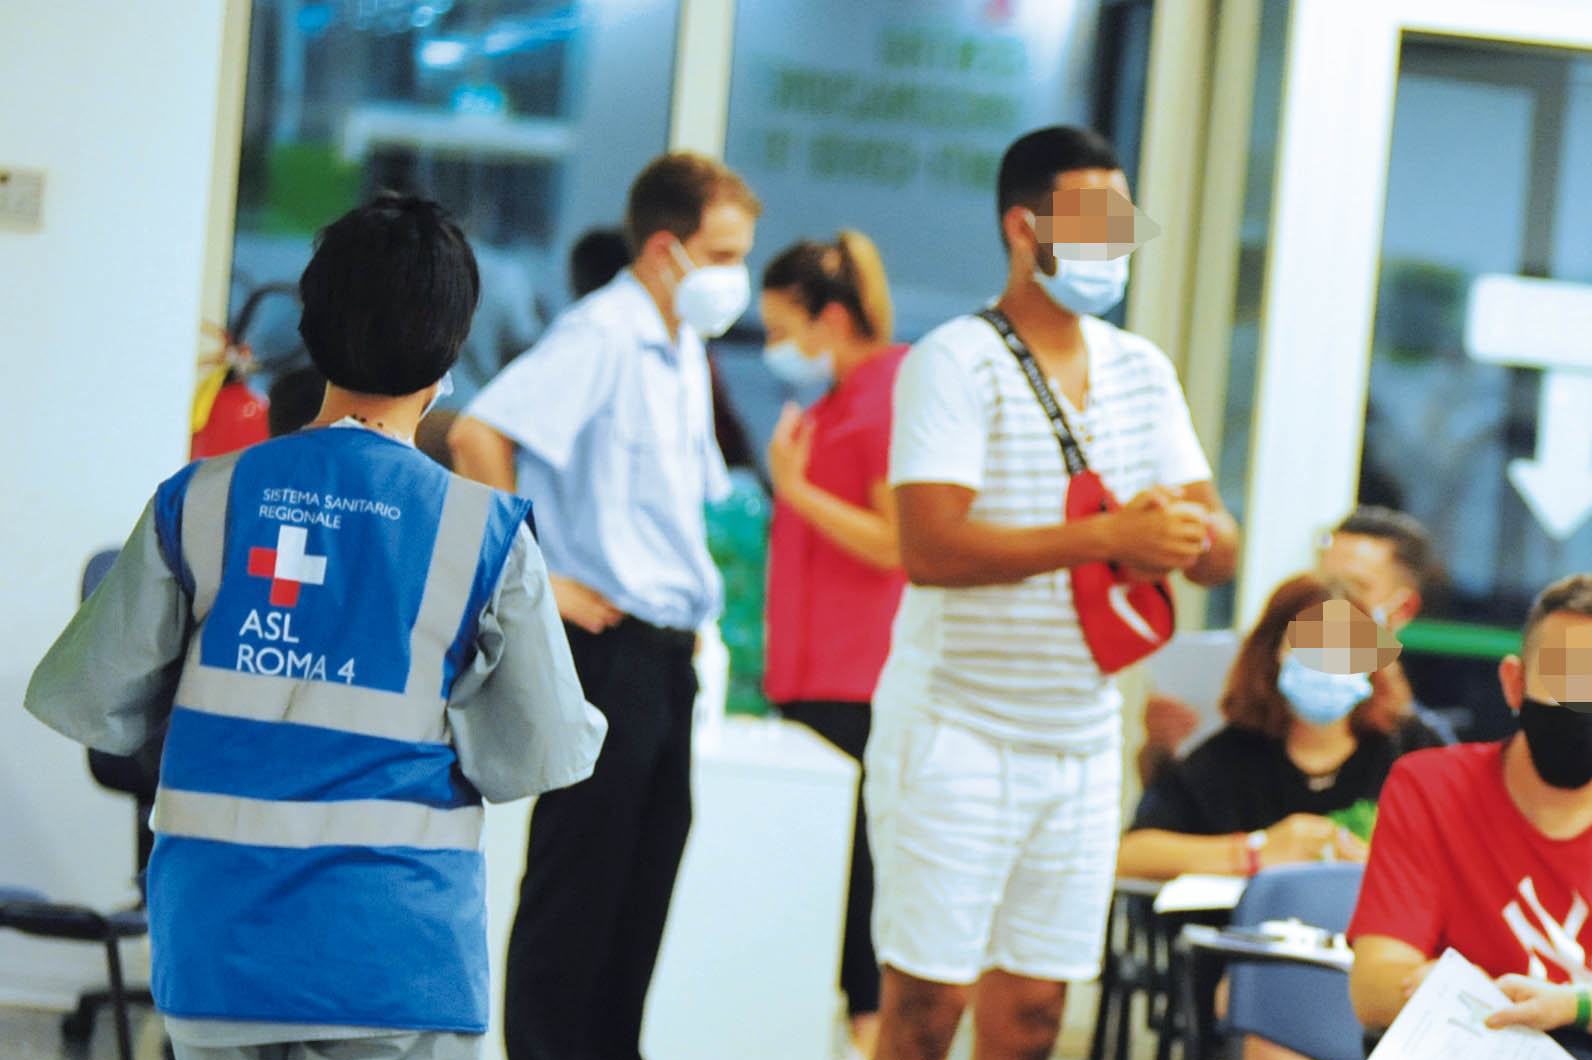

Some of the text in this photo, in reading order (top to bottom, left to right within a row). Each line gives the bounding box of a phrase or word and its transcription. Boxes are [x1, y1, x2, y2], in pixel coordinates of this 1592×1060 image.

[259, 505, 341, 529] REGIONALE
[263, 487, 401, 521] SISTEMA SANITARIO
[239, 609, 299, 643] ASL
[236, 644, 356, 684] ROMA 4
